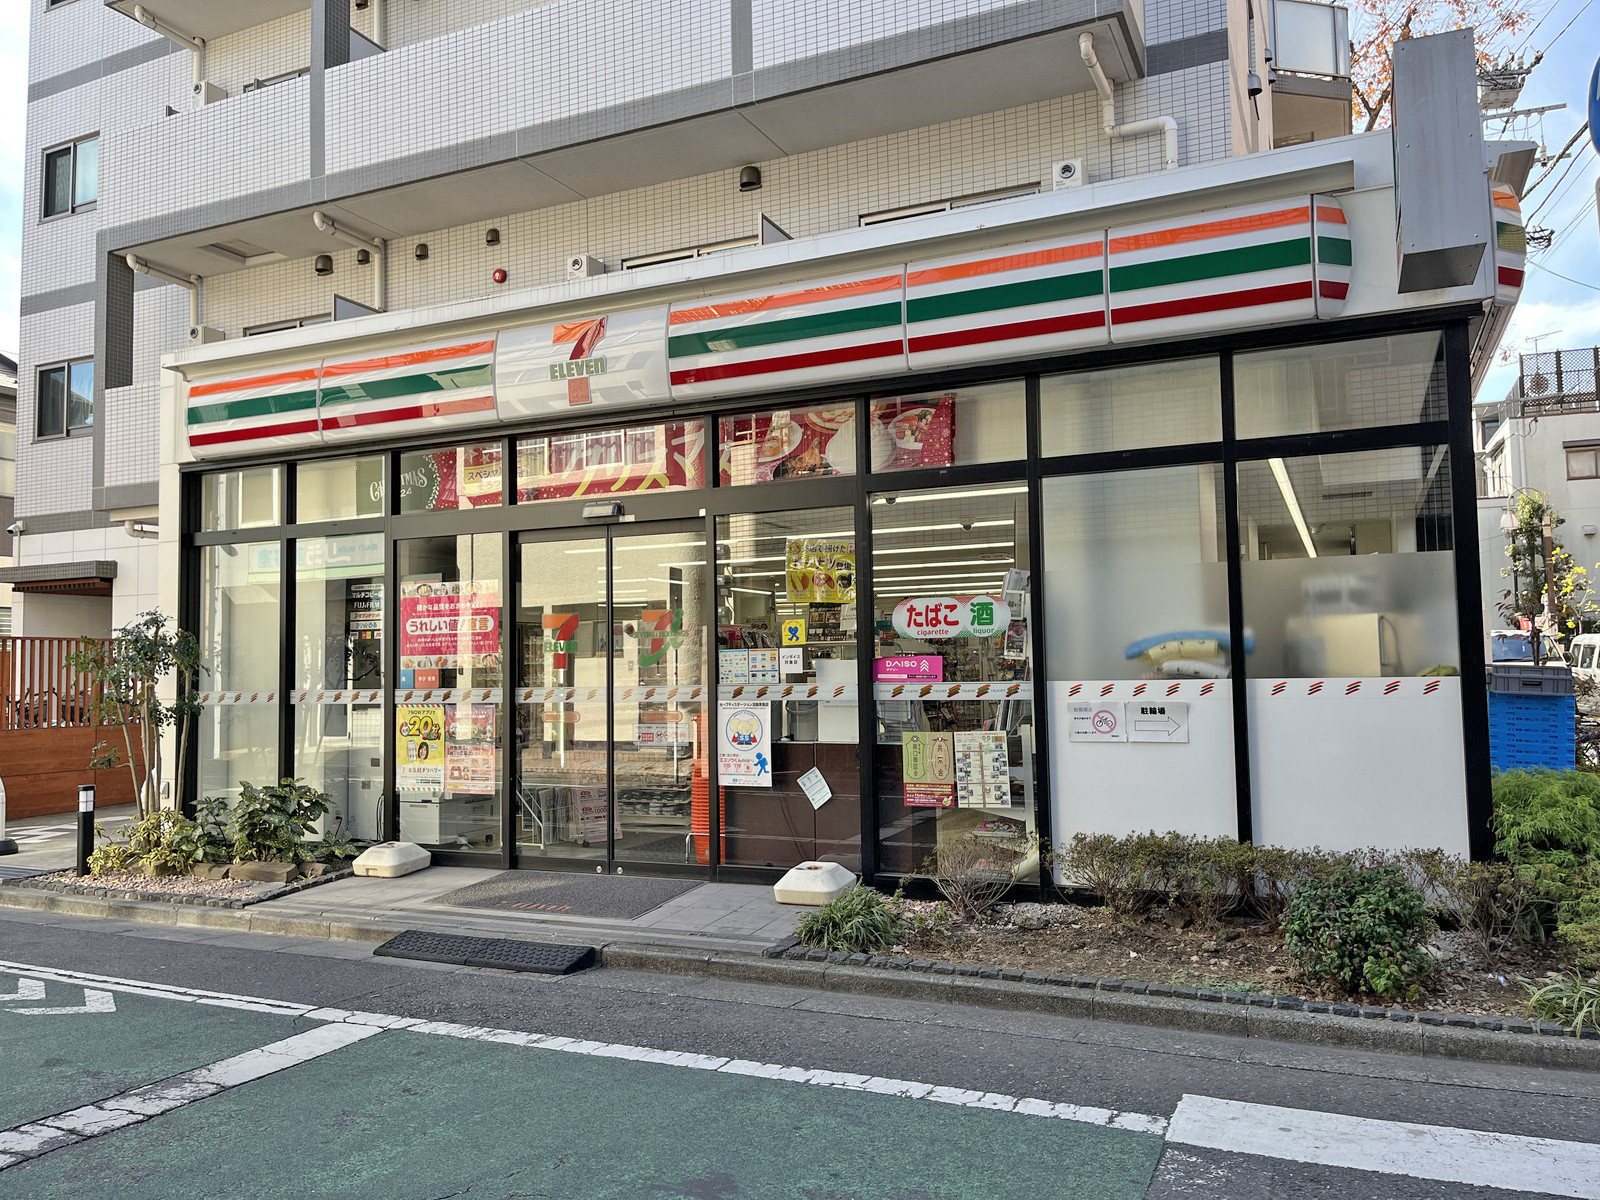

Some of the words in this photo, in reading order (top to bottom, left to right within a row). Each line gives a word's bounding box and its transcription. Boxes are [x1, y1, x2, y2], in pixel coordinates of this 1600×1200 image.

[907, 602, 959, 628] たばこ
[970, 602, 993, 626] 酒
[917, 628, 949, 636] cigarette
[1140, 707, 1165, 715] 駐輪場
